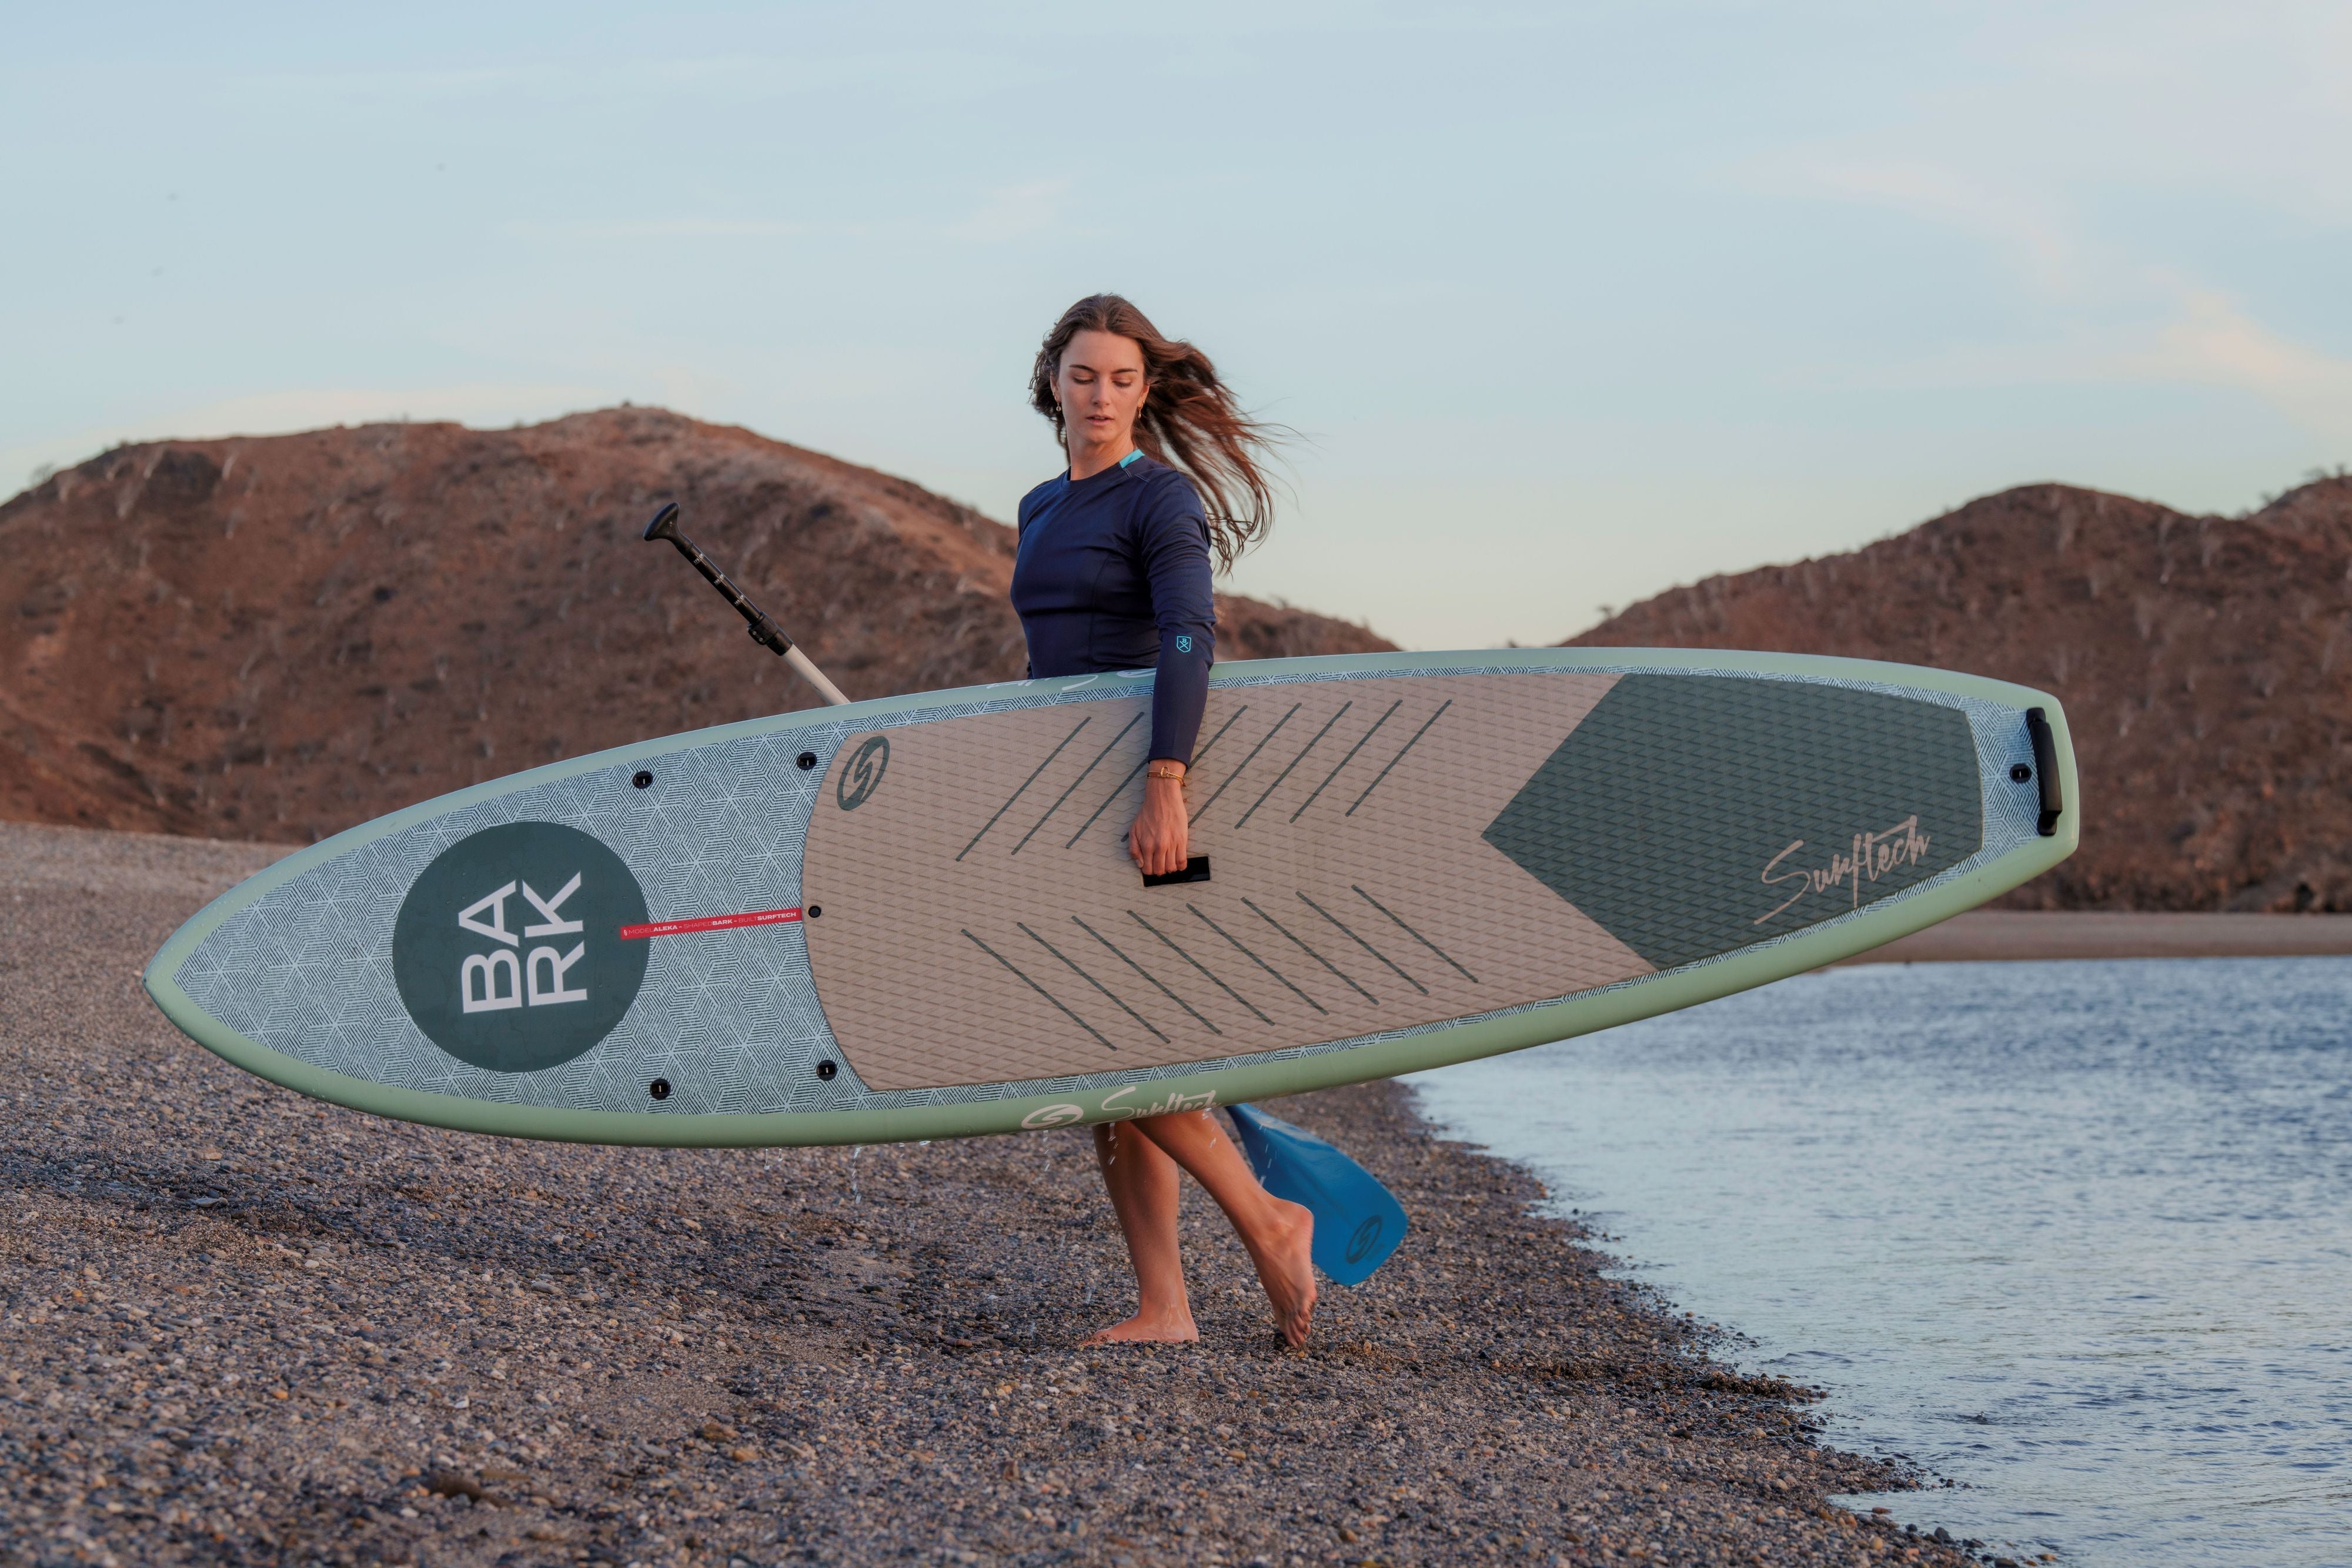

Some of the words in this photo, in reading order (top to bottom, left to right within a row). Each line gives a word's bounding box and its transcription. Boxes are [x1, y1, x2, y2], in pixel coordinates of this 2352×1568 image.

[1753, 815, 1931, 925] Surftech
[458, 880, 523, 1014] BA
[522, 870, 587, 1007] RK
